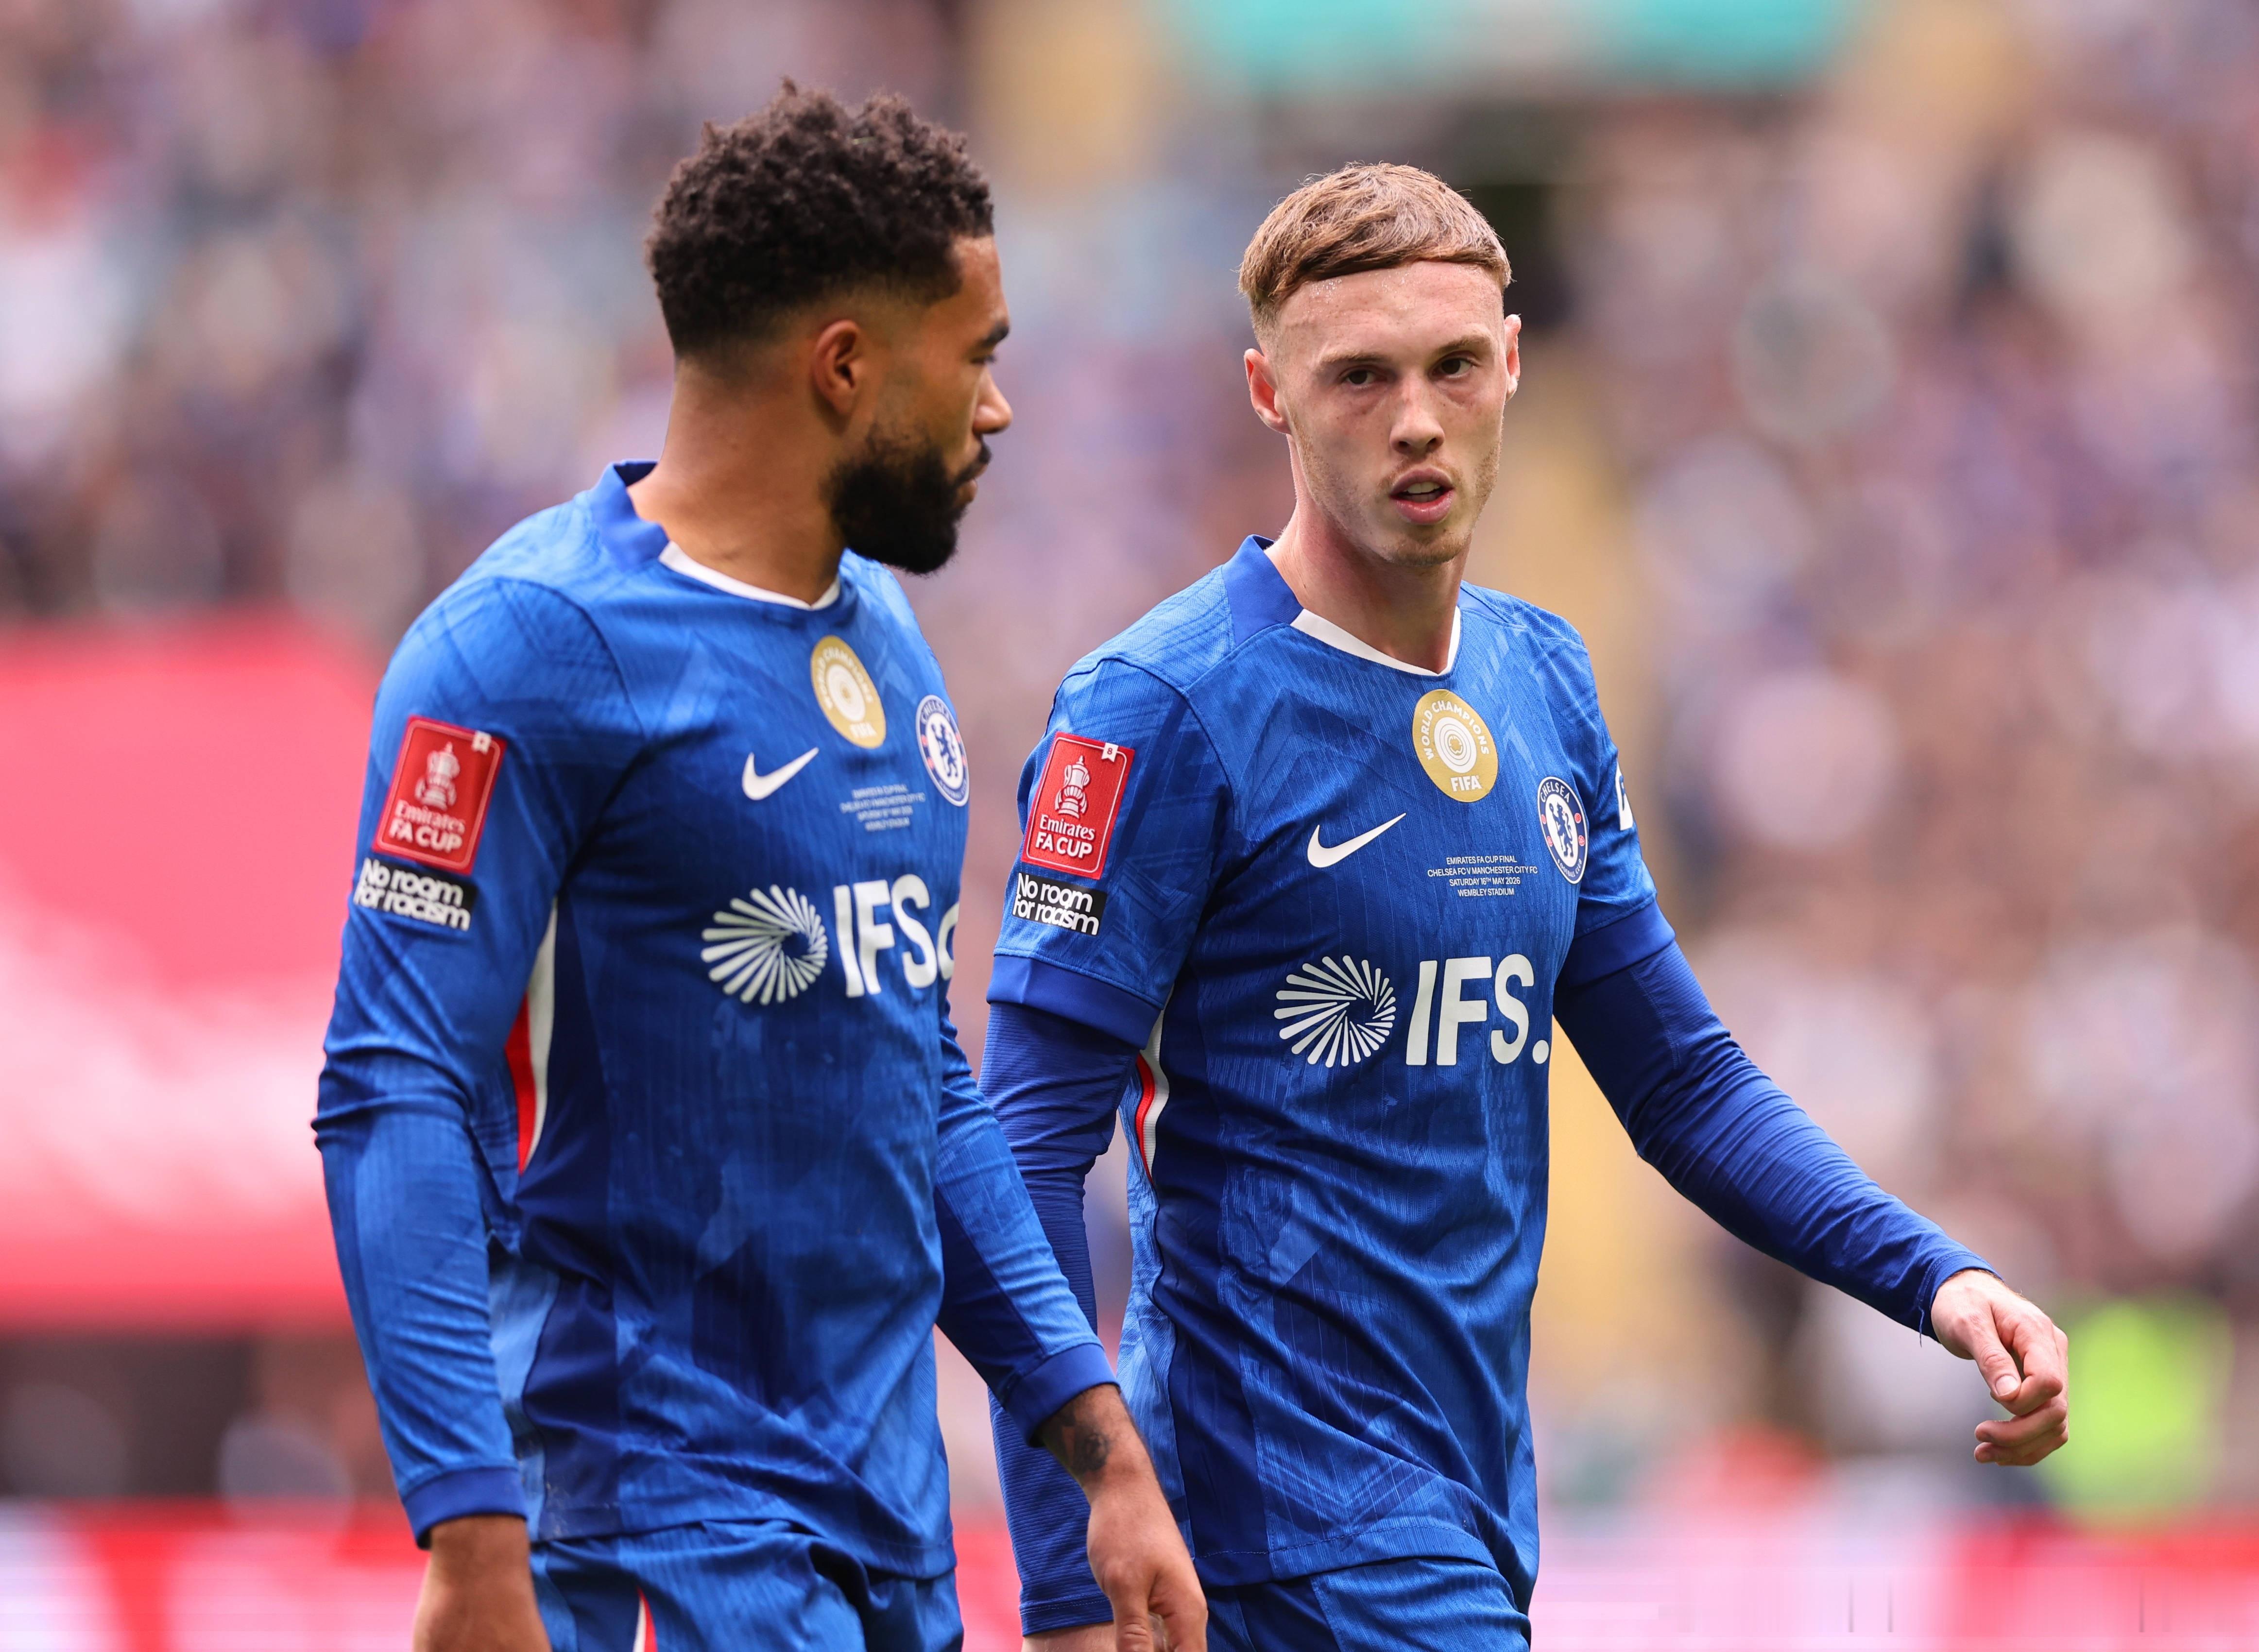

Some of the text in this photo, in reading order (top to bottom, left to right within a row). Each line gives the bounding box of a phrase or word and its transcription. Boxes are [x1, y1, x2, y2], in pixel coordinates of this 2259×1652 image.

[1421, 700, 1489, 760] WORLD CHAMPIONS
[1451, 776, 1482, 792] FIFA
[1540, 782, 1570, 802] CHELSEA
[394, 799, 466, 835] Emirates
[1040, 814, 1095, 840] Emirates
[389, 819, 462, 852] FA CUP
[1035, 832, 1092, 858] FA CUP
[1428, 868, 1457, 877] CHELSEA
[1446, 856, 1476, 865] EMIRATES
[360, 857, 464, 907] No room
[1016, 873, 1093, 912] No room
[1450, 878, 1480, 886] SATURDAY
[1458, 888, 1487, 897] WEMBLEY
[353, 884, 471, 931] for racism
[1013, 894, 1099, 935] for racism
[1406, 954, 1549, 1065] IFS.
